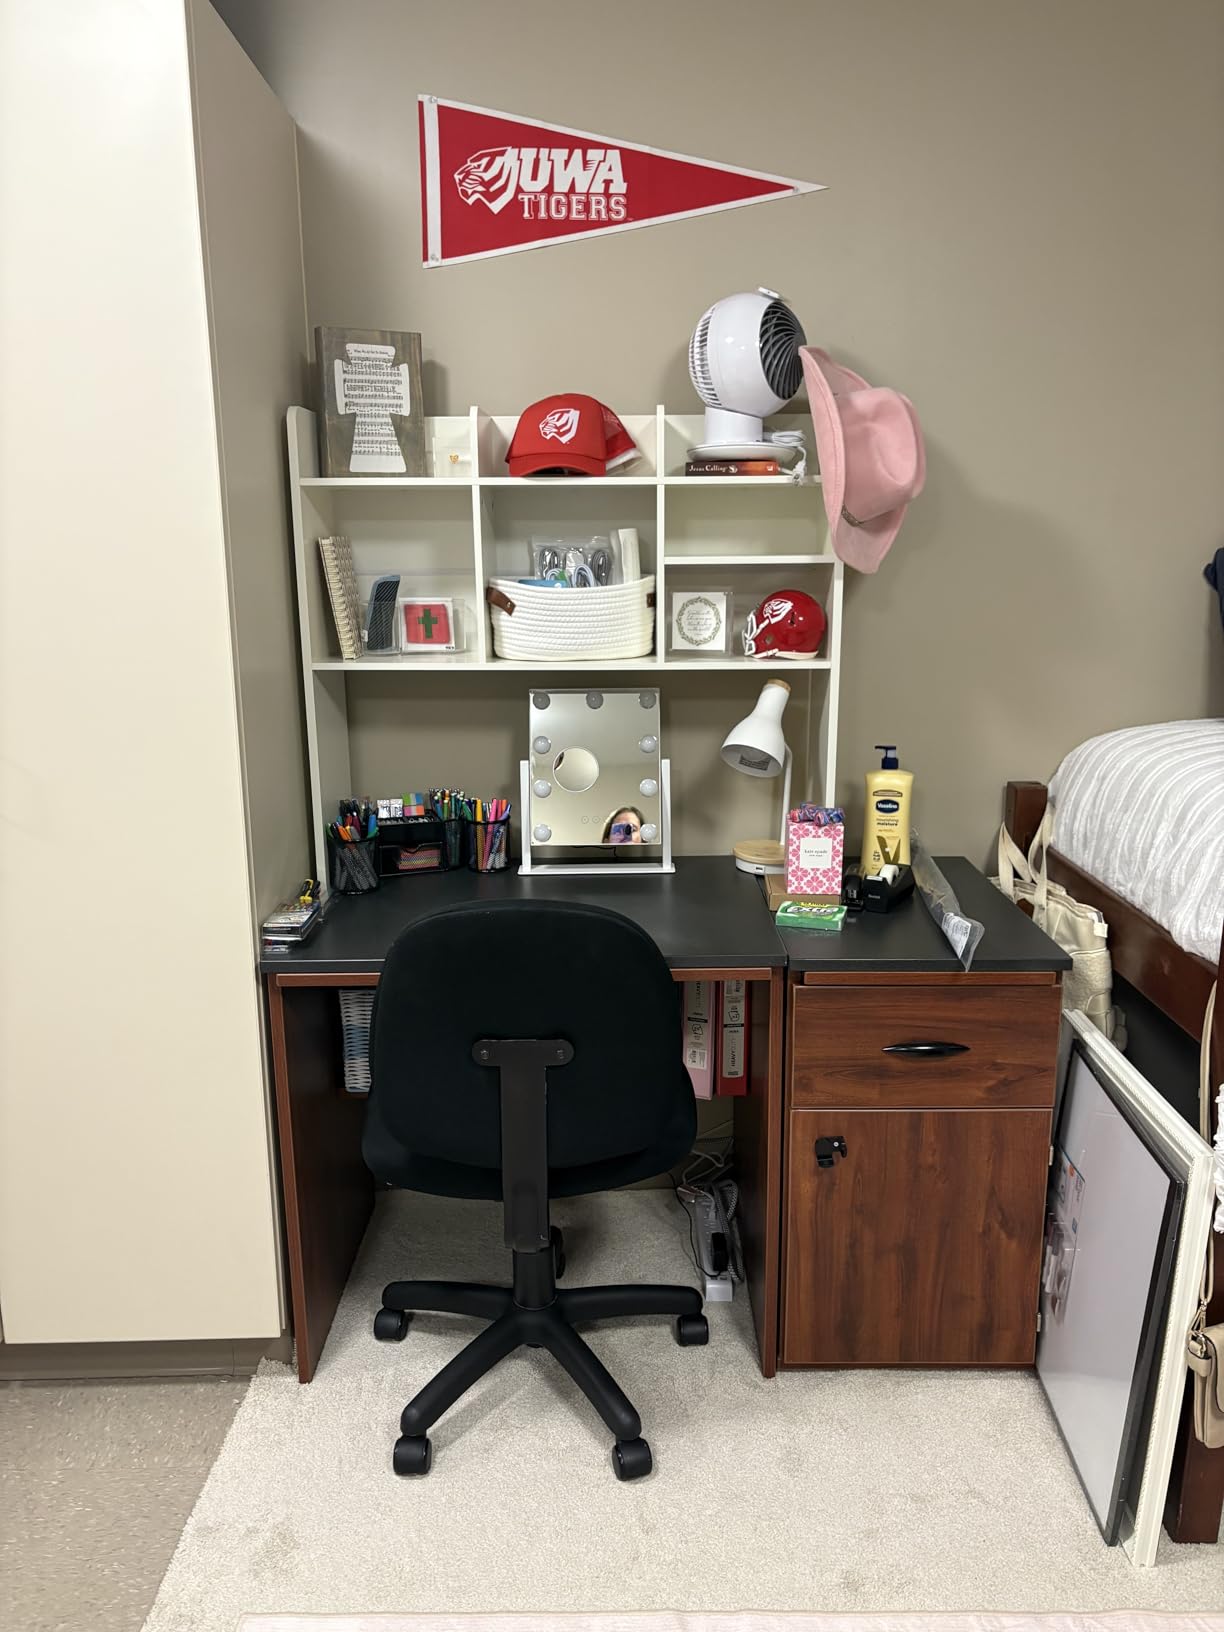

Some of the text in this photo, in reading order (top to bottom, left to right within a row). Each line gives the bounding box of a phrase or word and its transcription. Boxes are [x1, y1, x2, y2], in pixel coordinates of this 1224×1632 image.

[519, 147, 628, 194] UWA
[518, 192, 627, 221] TIGERS
[705, 464, 726, 473] Calling
